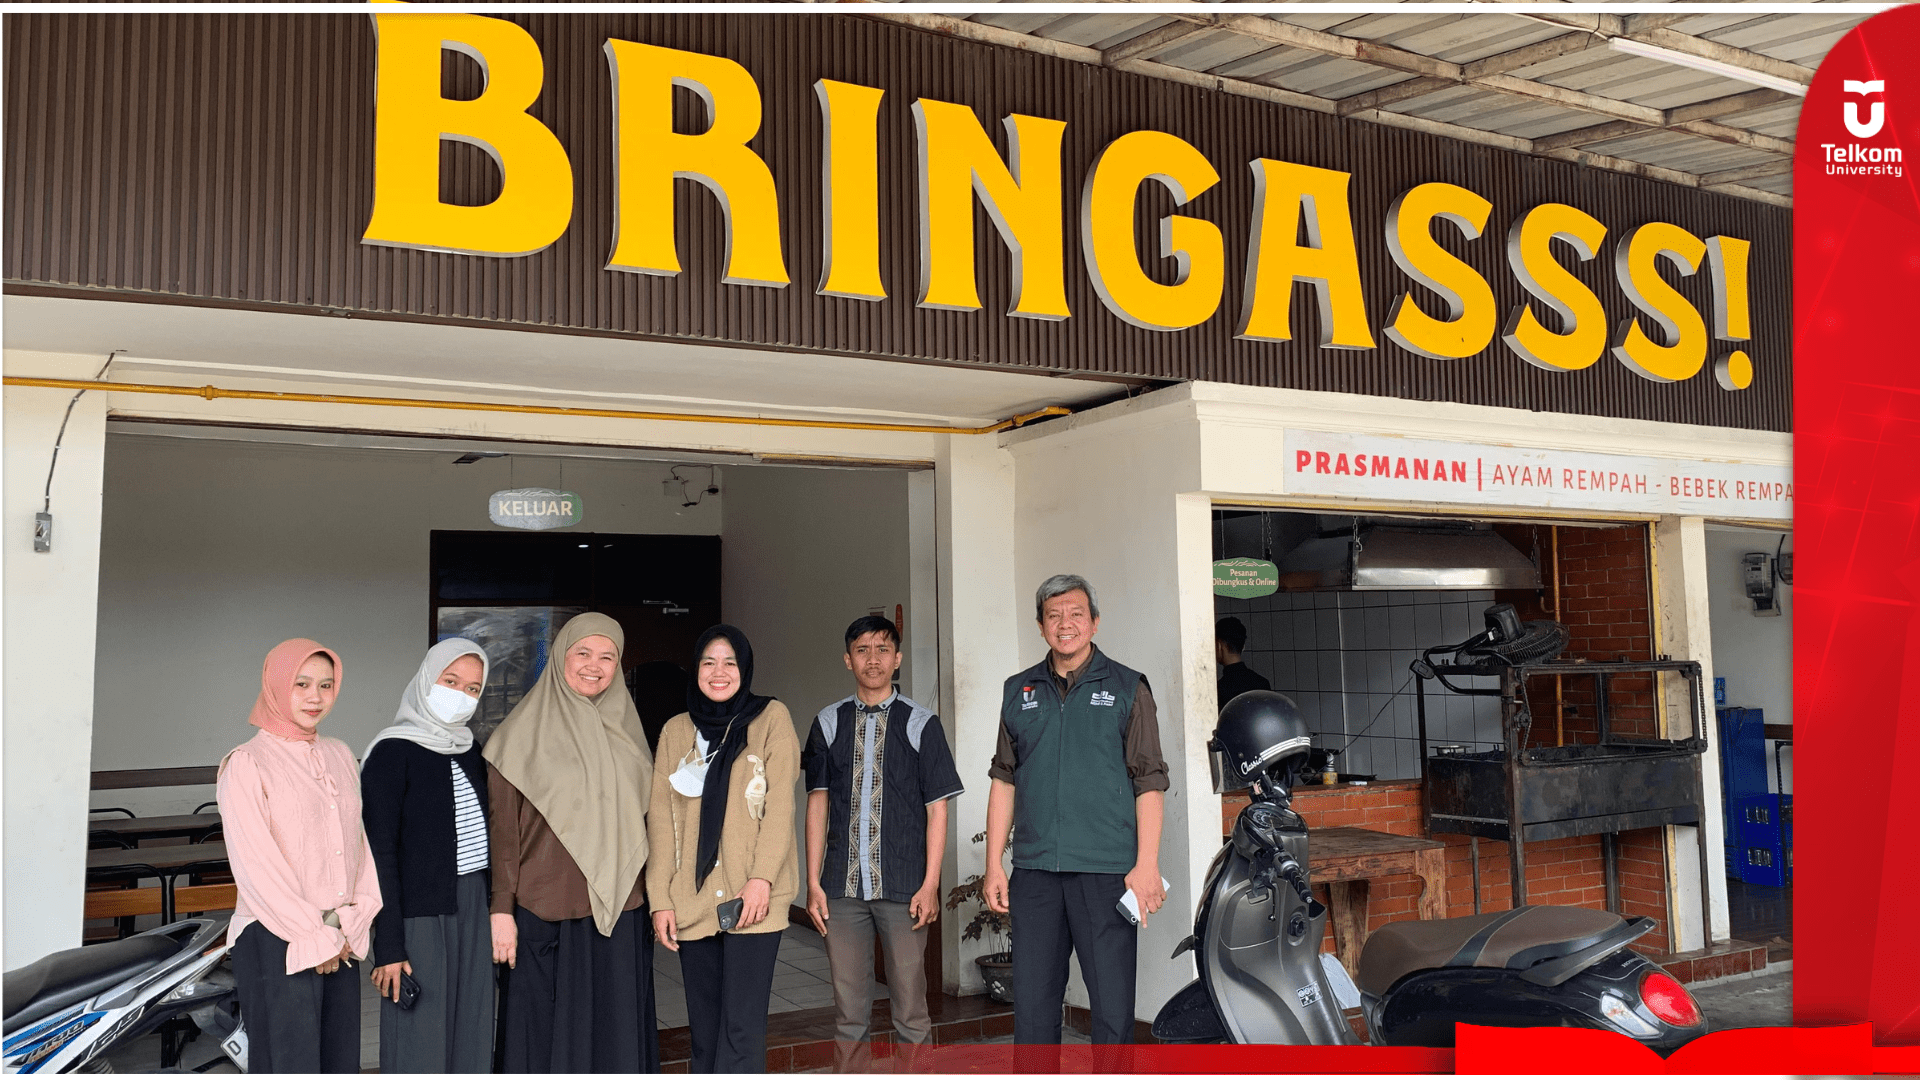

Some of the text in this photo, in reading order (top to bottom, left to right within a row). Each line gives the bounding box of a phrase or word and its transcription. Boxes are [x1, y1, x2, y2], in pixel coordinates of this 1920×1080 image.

[360, 0, 1753, 391] BRINGASSS!
[1296, 449, 1467, 483] PRASMANAN
[1492, 463, 1553, 488] AYAM
[1563, 468, 1647, 494] REMPAH
[1670, 476, 1729, 499] BEBEK
[499, 500, 573, 516] KELUAR
[1229, 568, 1258, 577] Pesanan
[1248, 577, 1255, 586] &
[1255, 577, 1277, 586] Online
[226, 1040, 242, 1056] D
